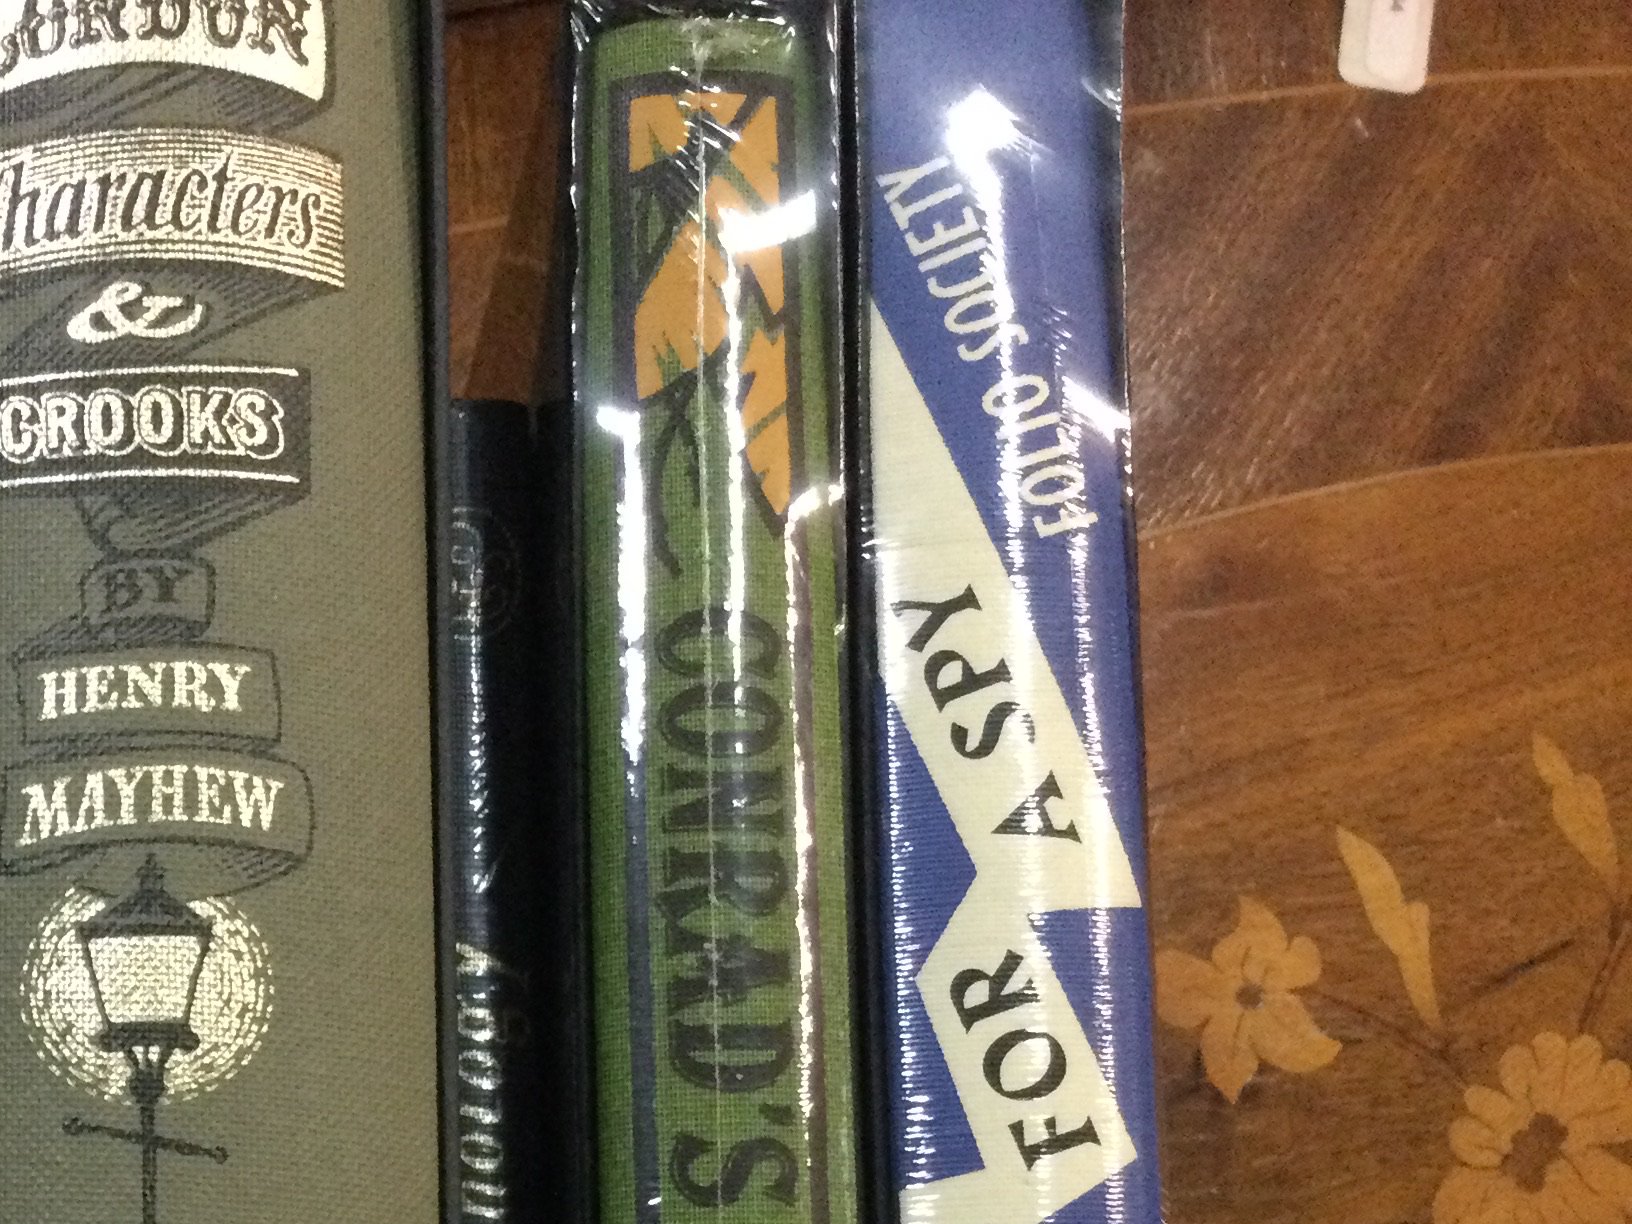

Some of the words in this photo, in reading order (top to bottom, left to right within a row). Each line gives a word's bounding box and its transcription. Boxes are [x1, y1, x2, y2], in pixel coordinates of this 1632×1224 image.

[66, 280, 204, 344] &
[876, 155, 1030, 363] SOCIETY
[981, 373, 1099, 539] FOLIO
[100, 564, 191, 607] BY
[36, 660, 251, 721] HENRY
[890, 583, 1037, 760] SPY
[15, 764, 285, 848] MAYHEW
[991, 769, 1083, 845] A
[654, 606, 800, 1208] CONRAD'S
[949, 948, 1103, 1172] FOR
